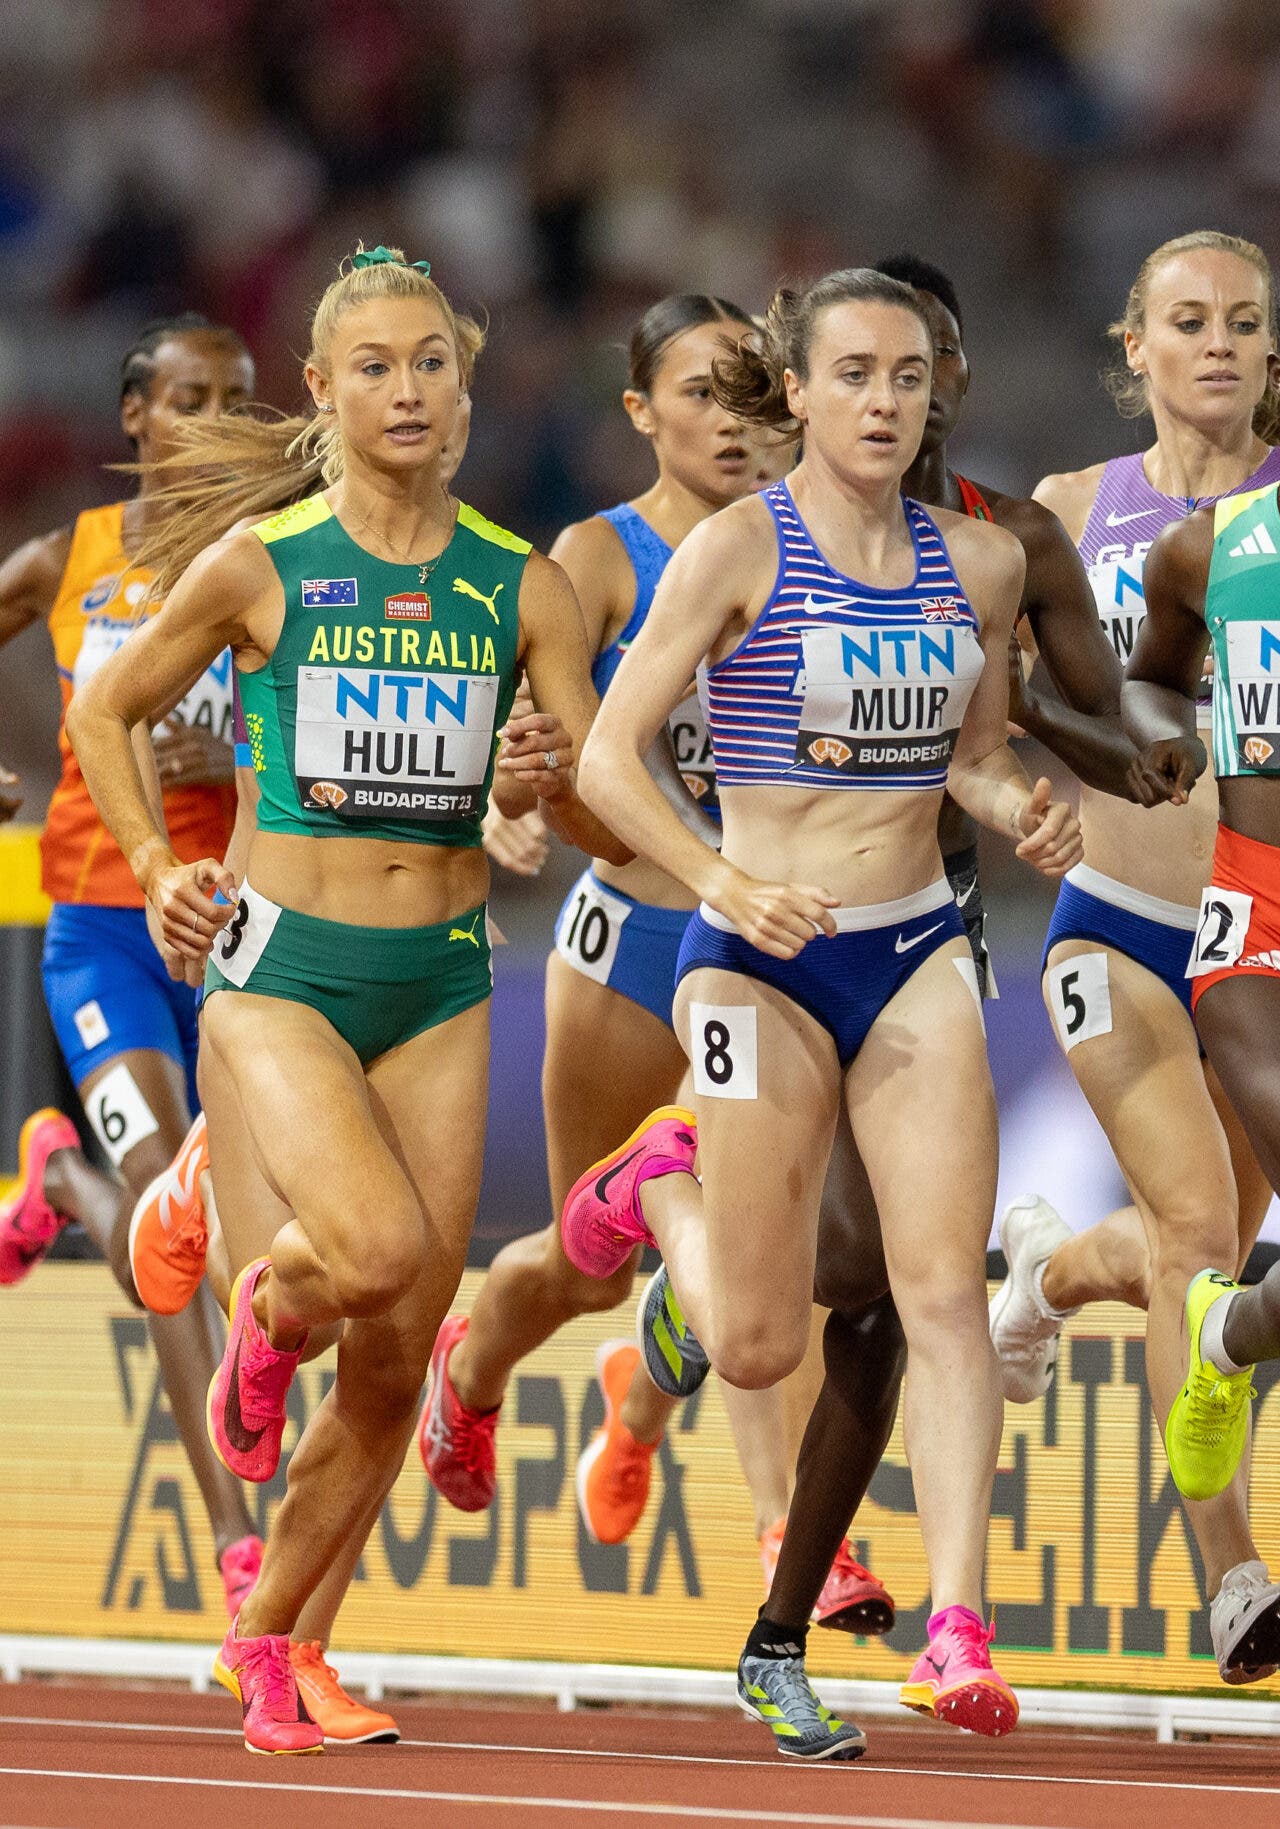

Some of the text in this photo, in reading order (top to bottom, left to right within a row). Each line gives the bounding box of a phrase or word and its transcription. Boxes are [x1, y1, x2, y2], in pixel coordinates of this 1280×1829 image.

[387, 600, 428, 612] CHEMIST
[307, 625, 497, 674] AUSTRALIA
[841, 628, 955, 680] NTN
[336, 671, 468, 728] NTN
[849, 686, 949, 732] MUIR
[343, 729, 456, 779] HULL
[858, 744, 943, 764] BUDAPEST
[354, 789, 472, 811] BUDAPEST 23
[567, 892, 609, 964] 10
[1195, 900, 1234, 962] 12
[1061, 971, 1086, 1035] 5
[703, 1020, 734, 1085] 8
[101, 1094, 126, 1143] 6
